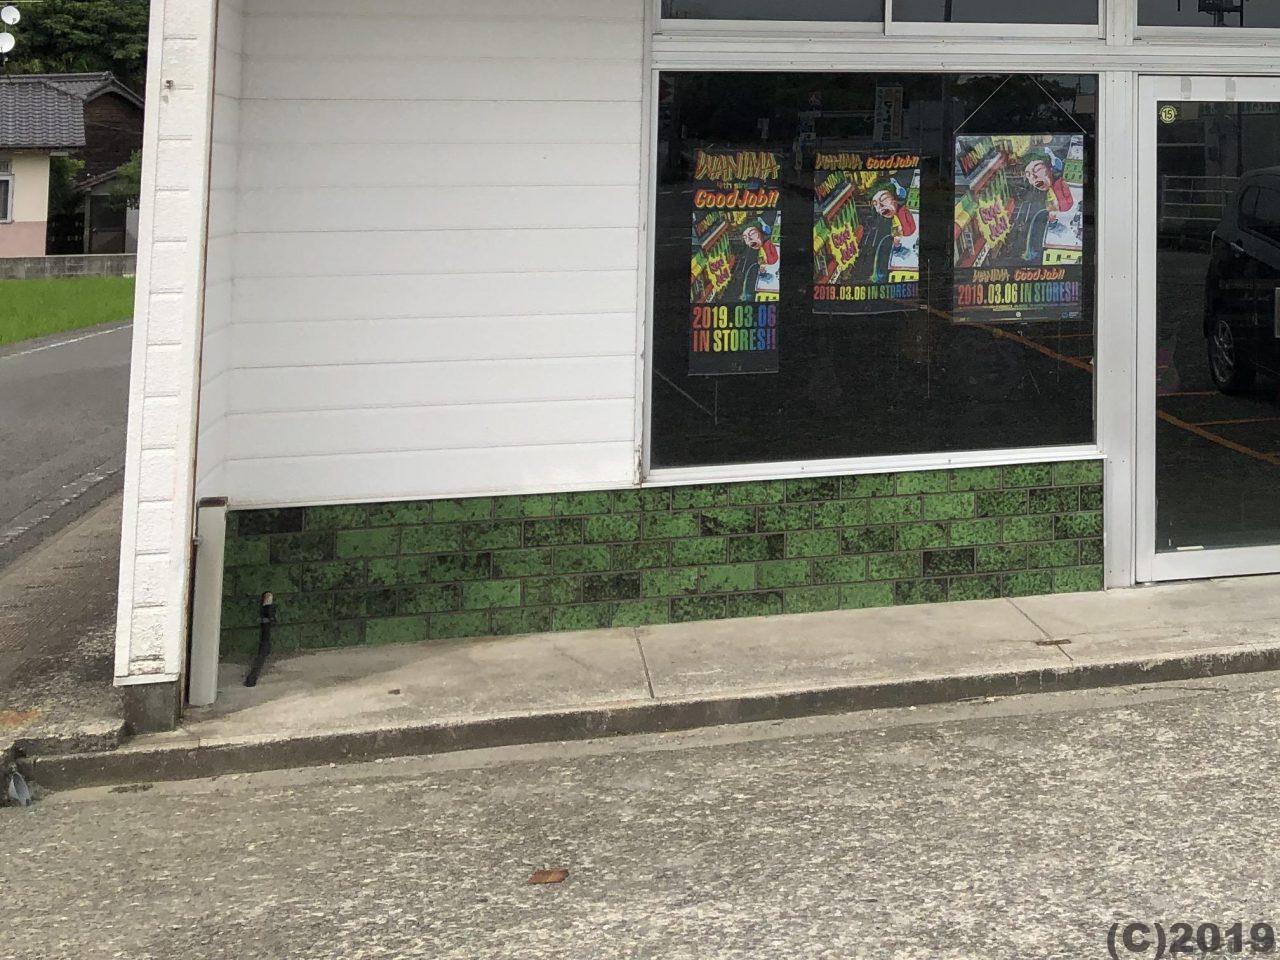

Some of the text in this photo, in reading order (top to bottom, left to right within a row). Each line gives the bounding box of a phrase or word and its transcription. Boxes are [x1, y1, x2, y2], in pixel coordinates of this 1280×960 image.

[813, 282, 918, 300] 2019.03.06 IN STORES!!
[958, 281, 1079, 305] 2019.03.06 IN STORES!!
[692, 304, 777, 329] 2019.03.06
[693, 328, 777, 352] IN STORES!!
